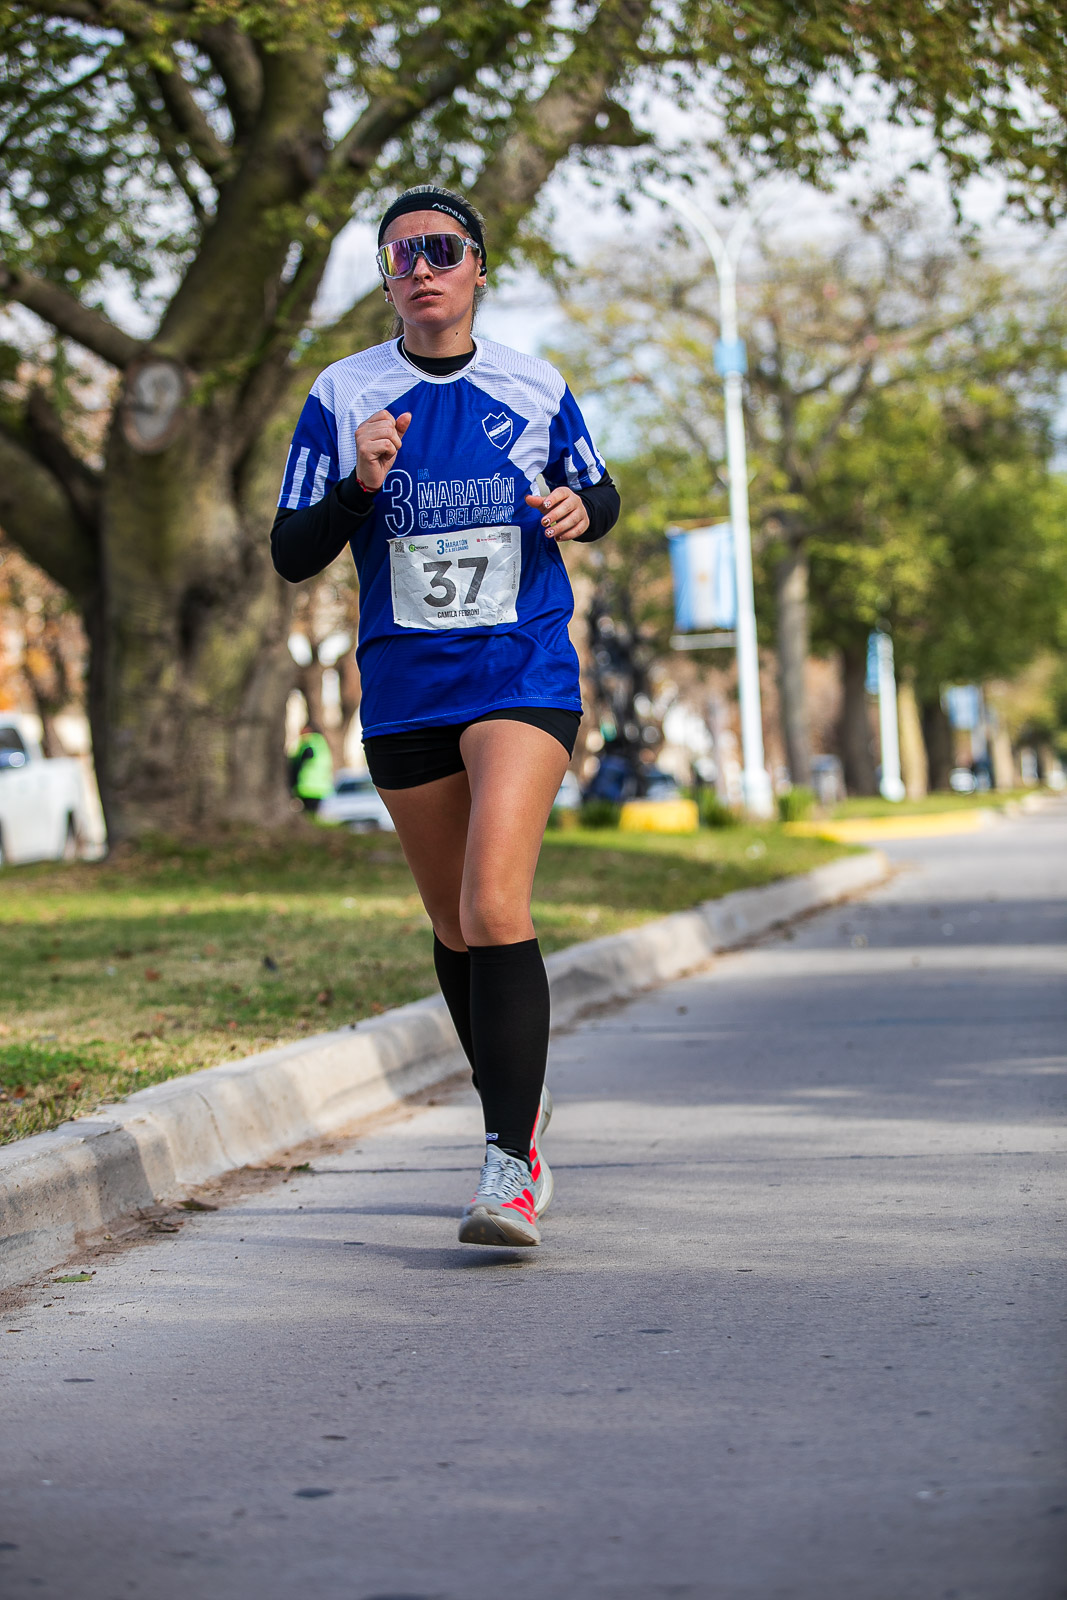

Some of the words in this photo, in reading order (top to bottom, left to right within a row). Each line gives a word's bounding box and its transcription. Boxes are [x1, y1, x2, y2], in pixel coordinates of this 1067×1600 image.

[383, 469, 414, 538] 3
[417, 472, 515, 509] MARATÓN
[436, 539, 445, 555] 3
[423, 556, 489, 608] 37
[437, 610, 458, 619] CAMILA
